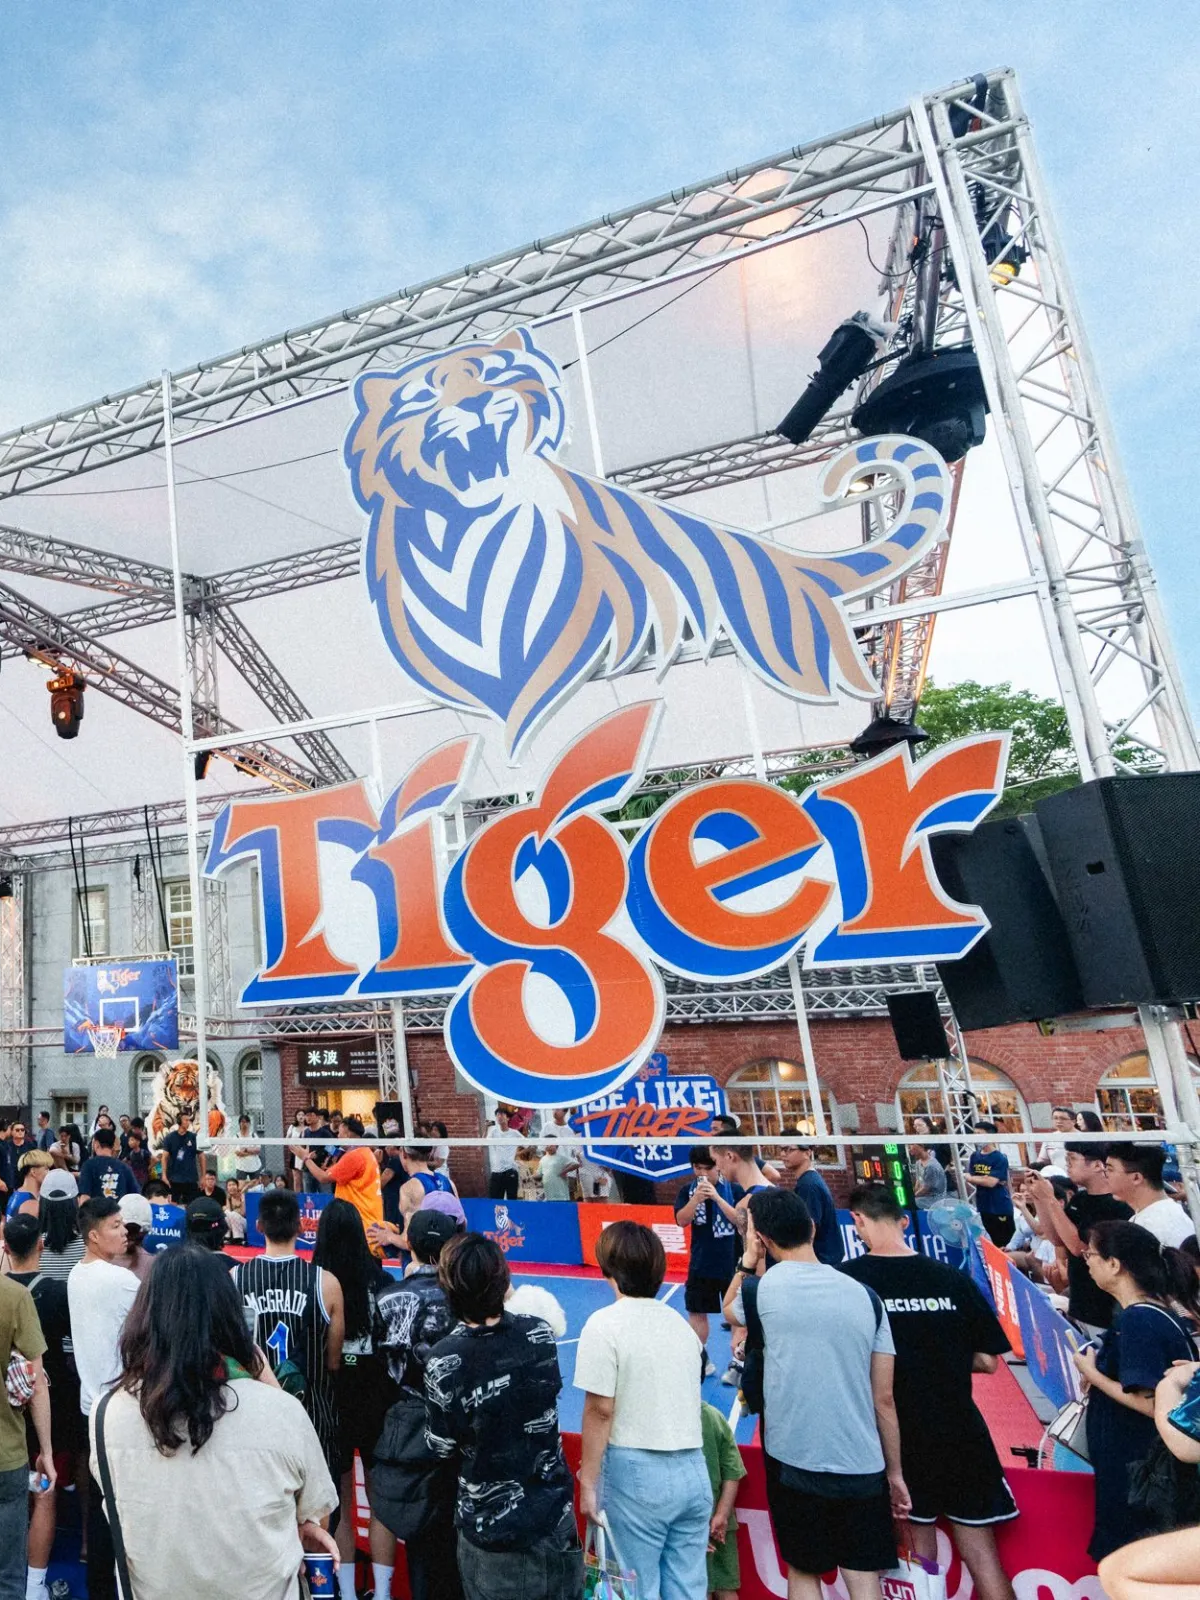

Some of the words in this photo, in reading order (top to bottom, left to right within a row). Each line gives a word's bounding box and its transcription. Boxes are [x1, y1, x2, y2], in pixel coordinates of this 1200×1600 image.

[204, 699, 1011, 1108] Tiger
[109, 968, 141, 987] Tiger
[308, 1050, 338, 1066] 米波
[635, 1080, 714, 1112] LIKE
[574, 1097, 713, 1137] TIGER
[483, 1230, 526, 1253] Tiger
[883, 1298, 957, 1312] ECISION.
[461, 1374, 511, 1413] HUF
